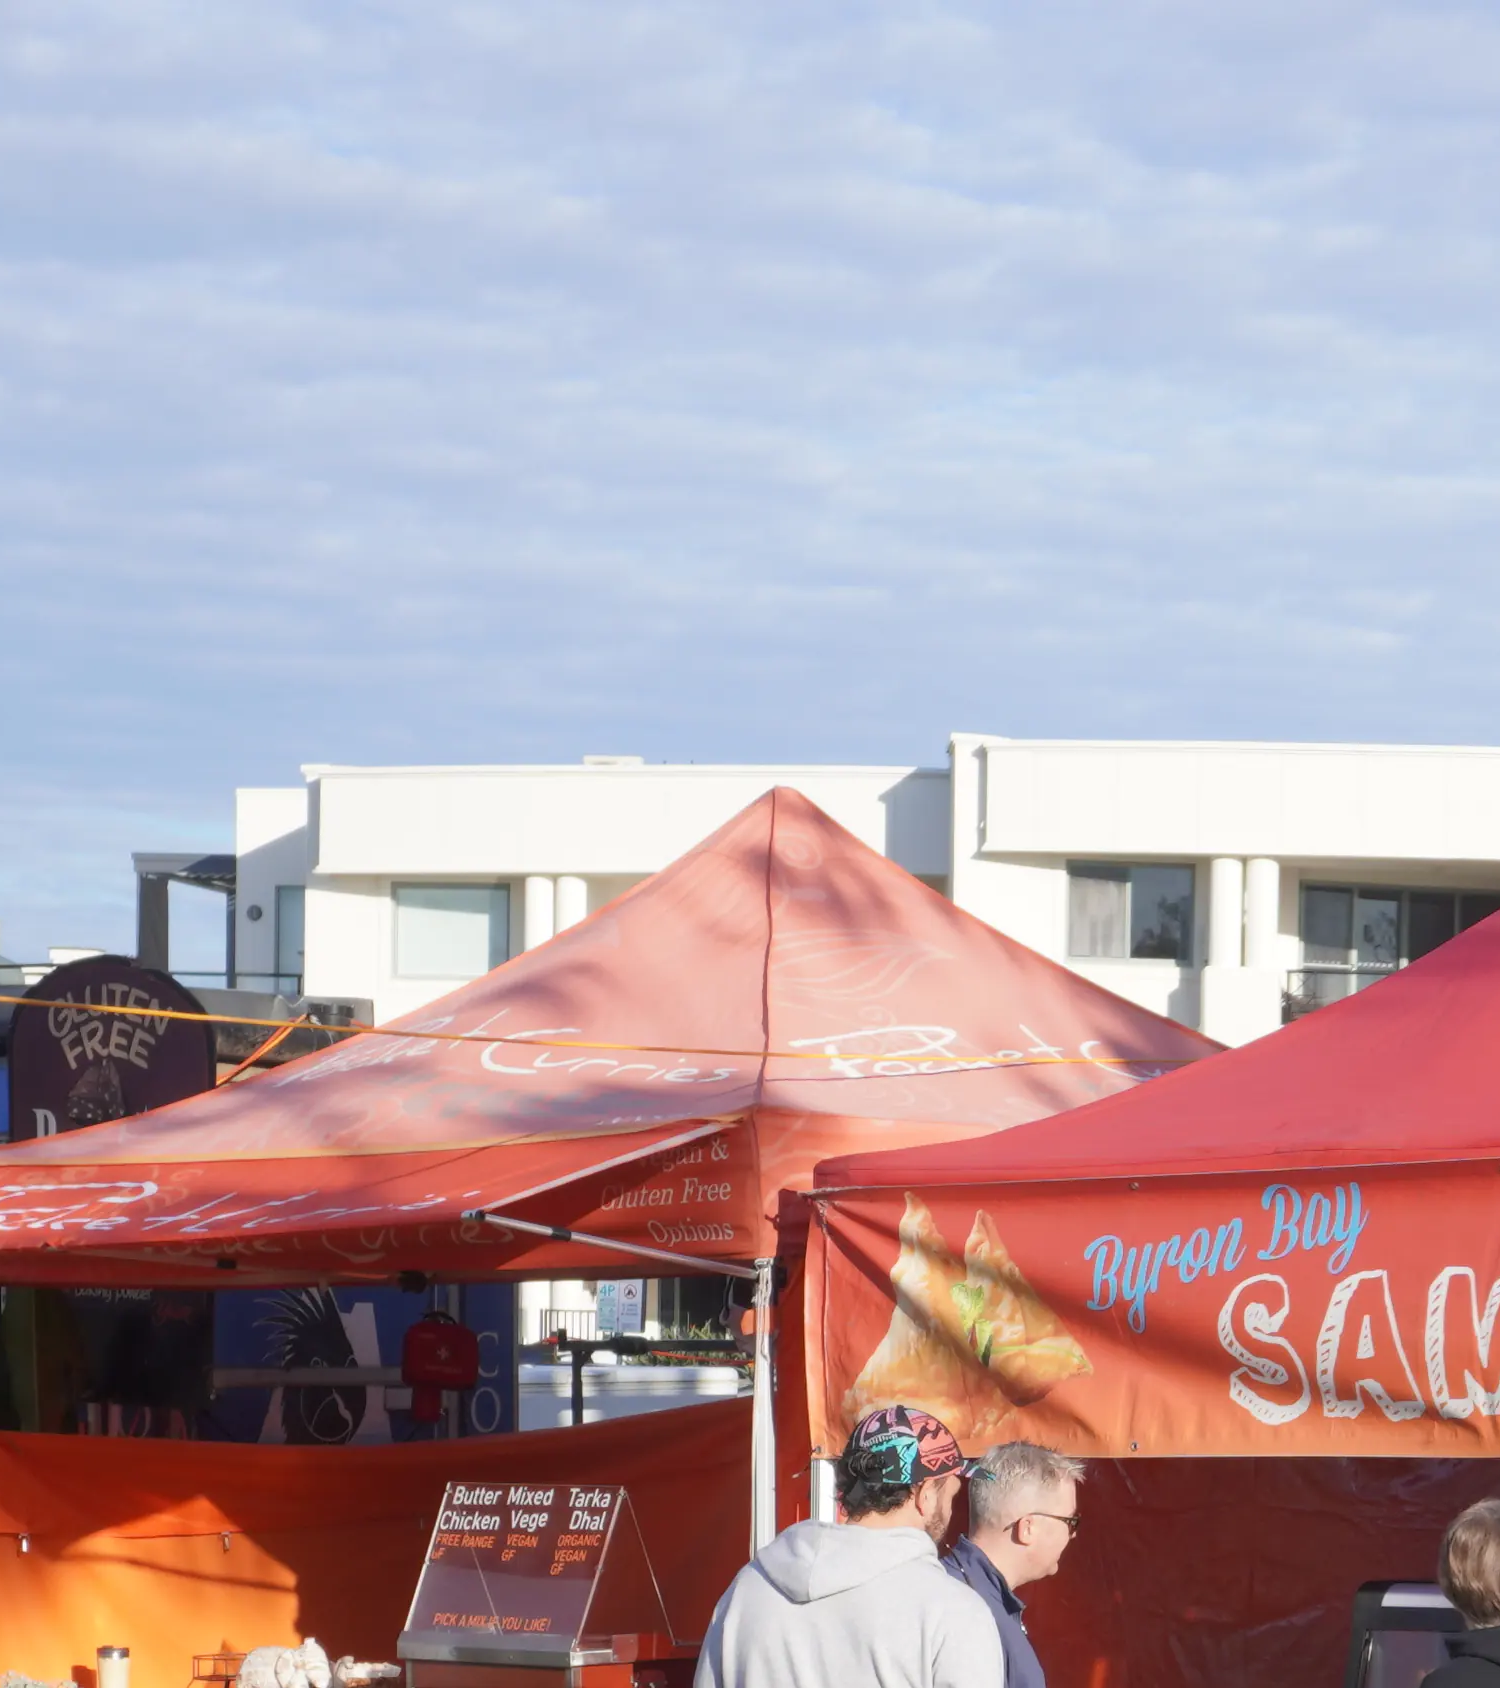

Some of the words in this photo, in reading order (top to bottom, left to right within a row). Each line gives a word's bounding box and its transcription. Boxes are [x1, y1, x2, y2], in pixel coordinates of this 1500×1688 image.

[48, 982, 173, 1038] GLUTEN
[60, 1019, 156, 1070] FREE
[480, 1027, 738, 1084] Curries
[710, 1137, 730, 1160] &
[600, 1182, 676, 1213] Gluten
[681, 1177, 732, 1204] Free
[647, 1220, 735, 1248] Options
[1084, 1217, 1247, 1334] Byron
[1256, 1181, 1372, 1276] Bay
[599, 1284, 616, 1297] 4P
[452, 1485, 503, 1505] Butter
[506, 1487, 555, 1506] Mixed
[569, 1488, 611, 1508] Tarka
[439, 1511, 500, 1531] Chicken
[511, 1511, 549, 1532] Vege
[569, 1511, 607, 1531] Dhal
[436, 1533, 460, 1547] FREE
[461, 1534, 496, 1548] RANGE
[506, 1534, 539, 1547] VEGAN
[557, 1534, 601, 1546] ORGANIC
[501, 1549, 517, 1562] GF
[554, 1550, 588, 1562] VEGAN
[550, 1563, 565, 1576] GF
[433, 1613, 457, 1627] PICK
[458, 1614, 467, 1627] A
[501, 1616, 522, 1630] YOU
[523, 1618, 552, 1631] LIKE!
